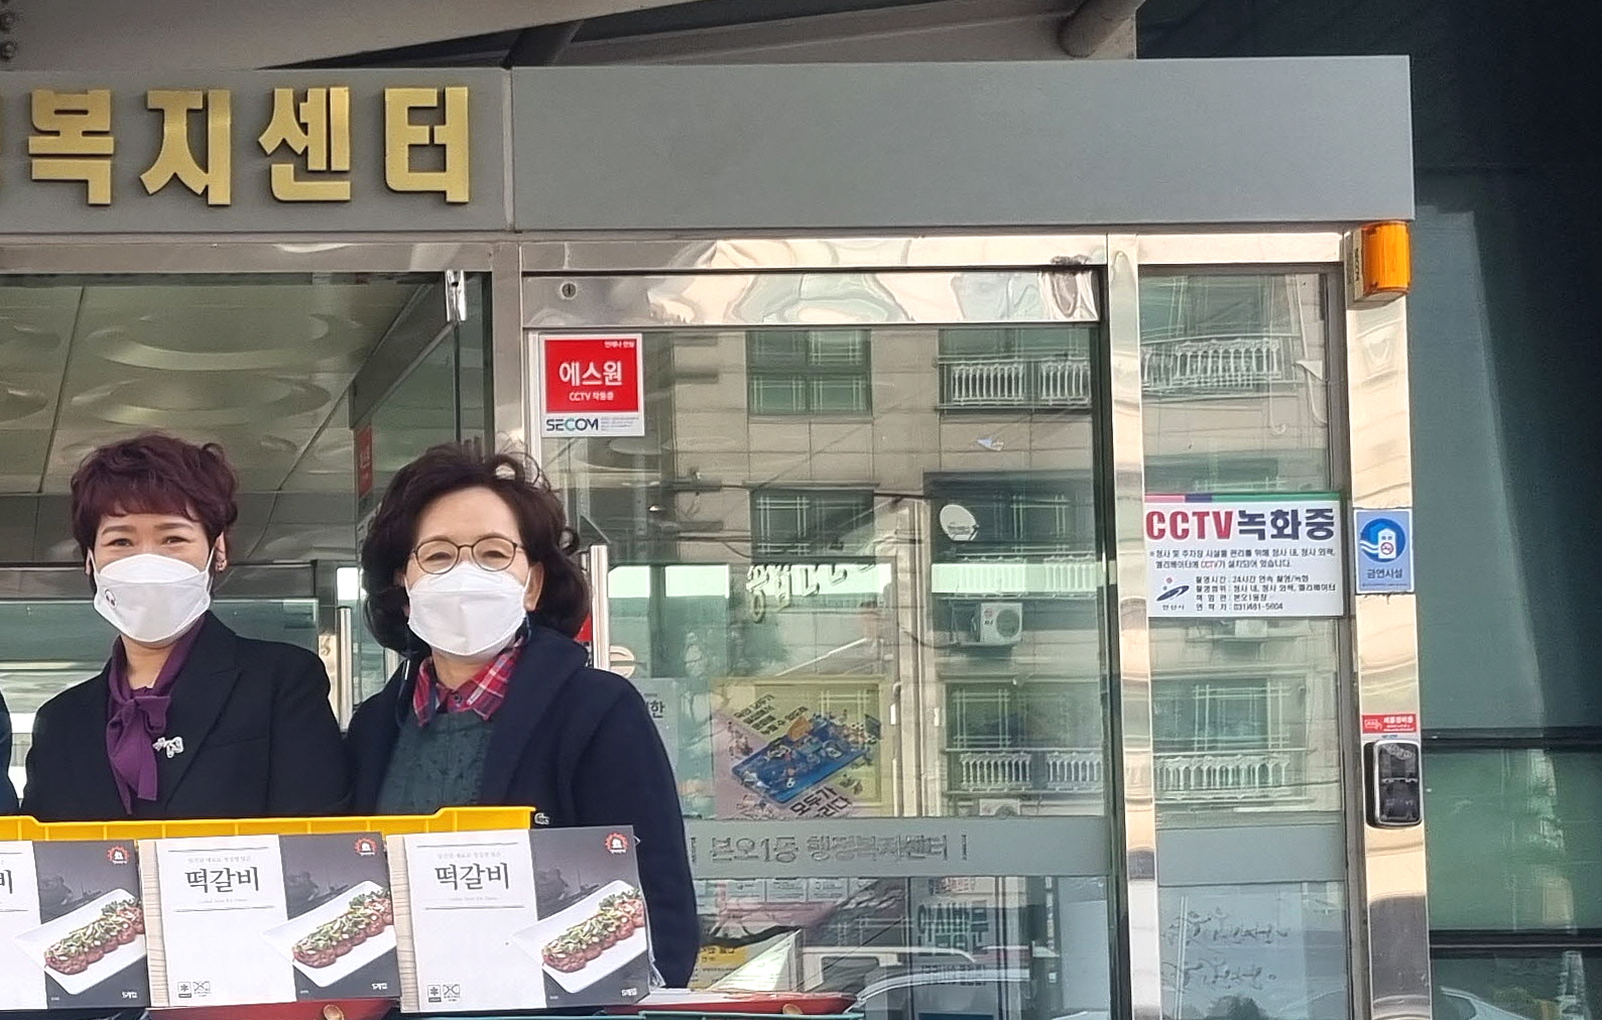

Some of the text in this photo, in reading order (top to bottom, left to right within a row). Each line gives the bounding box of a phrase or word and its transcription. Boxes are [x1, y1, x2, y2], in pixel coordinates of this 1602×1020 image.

[559, 361, 622, 386] 에스원
[569, 392, 591, 401] CCTV
[546, 418, 599, 431] SECOM
[184, 866, 260, 892] 떡갈비
[434, 863, 510, 890] 떡갈비
